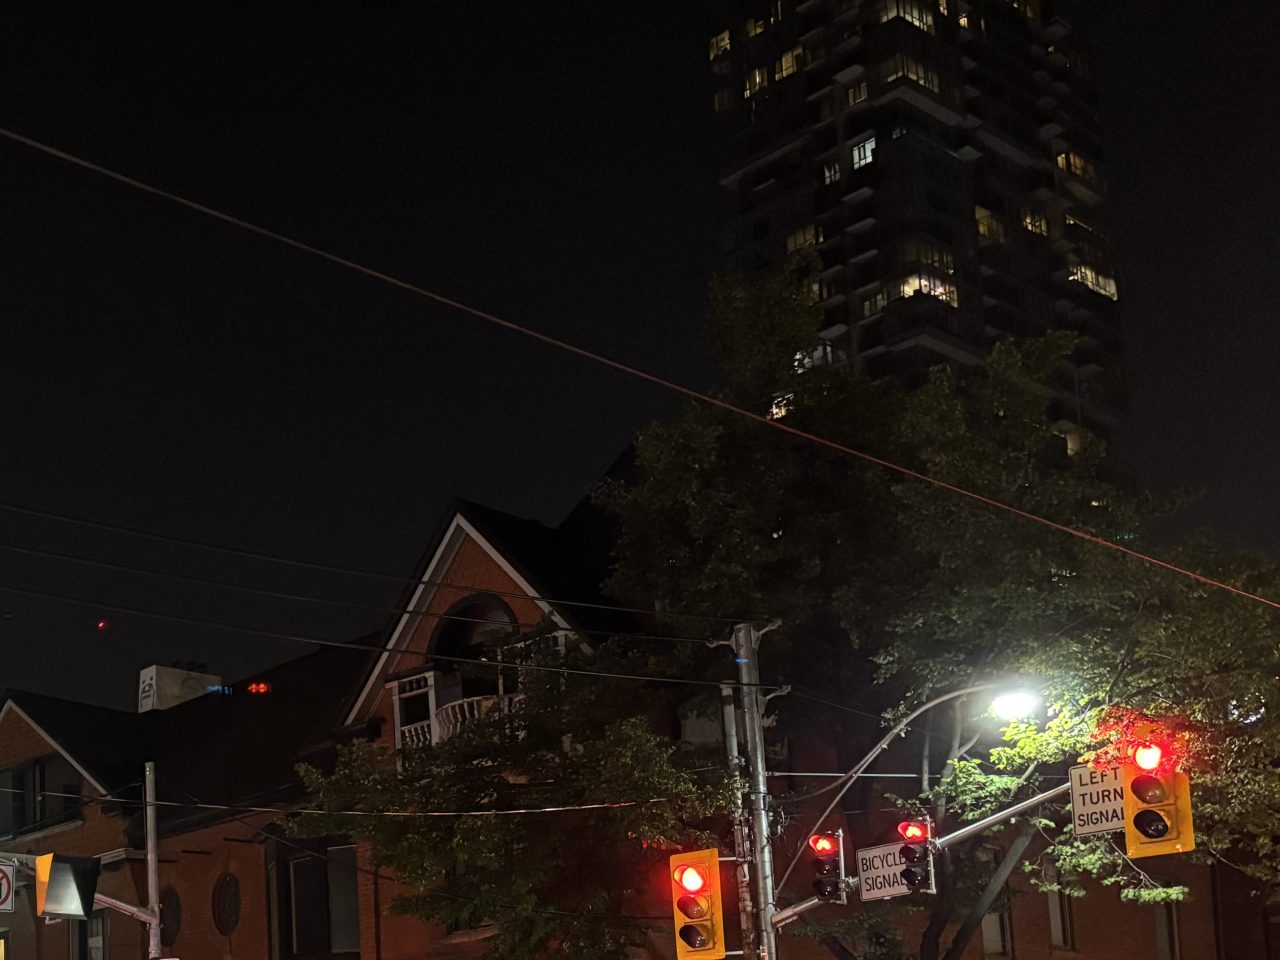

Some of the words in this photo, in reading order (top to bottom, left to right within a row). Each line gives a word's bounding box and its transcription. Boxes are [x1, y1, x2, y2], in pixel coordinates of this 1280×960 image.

[1078, 766, 1120, 786] LEFT
[1078, 786, 1124, 807] TURN
[864, 871, 908, 892] SIGNAL
